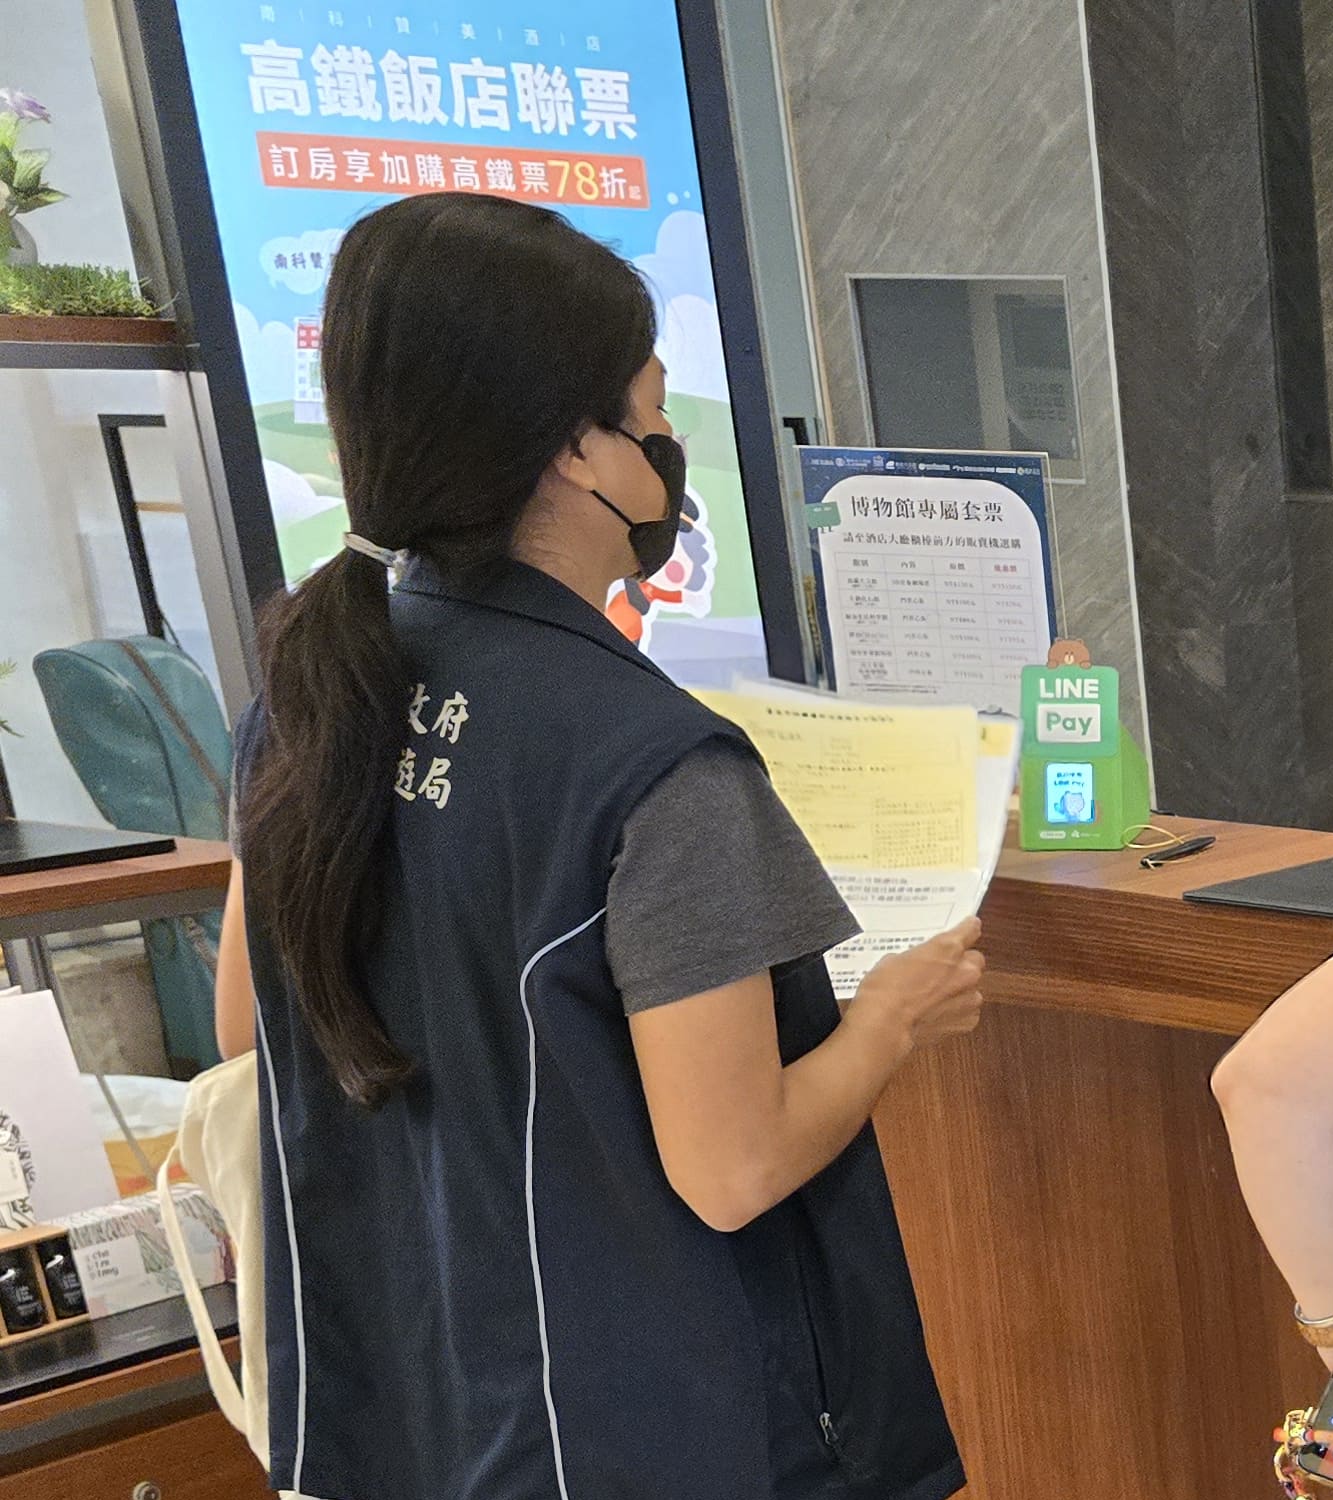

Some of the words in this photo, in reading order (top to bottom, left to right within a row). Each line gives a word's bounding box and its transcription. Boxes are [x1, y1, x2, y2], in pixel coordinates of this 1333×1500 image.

[239, 39, 638, 141] 高鐵飯店聯票
[274, 252, 334, 270] 南科贊
[850, 495, 1005, 523] 博物館專屬套票
[1039, 678, 1100, 700] LINE
[1045, 711, 1093, 736] Pay
